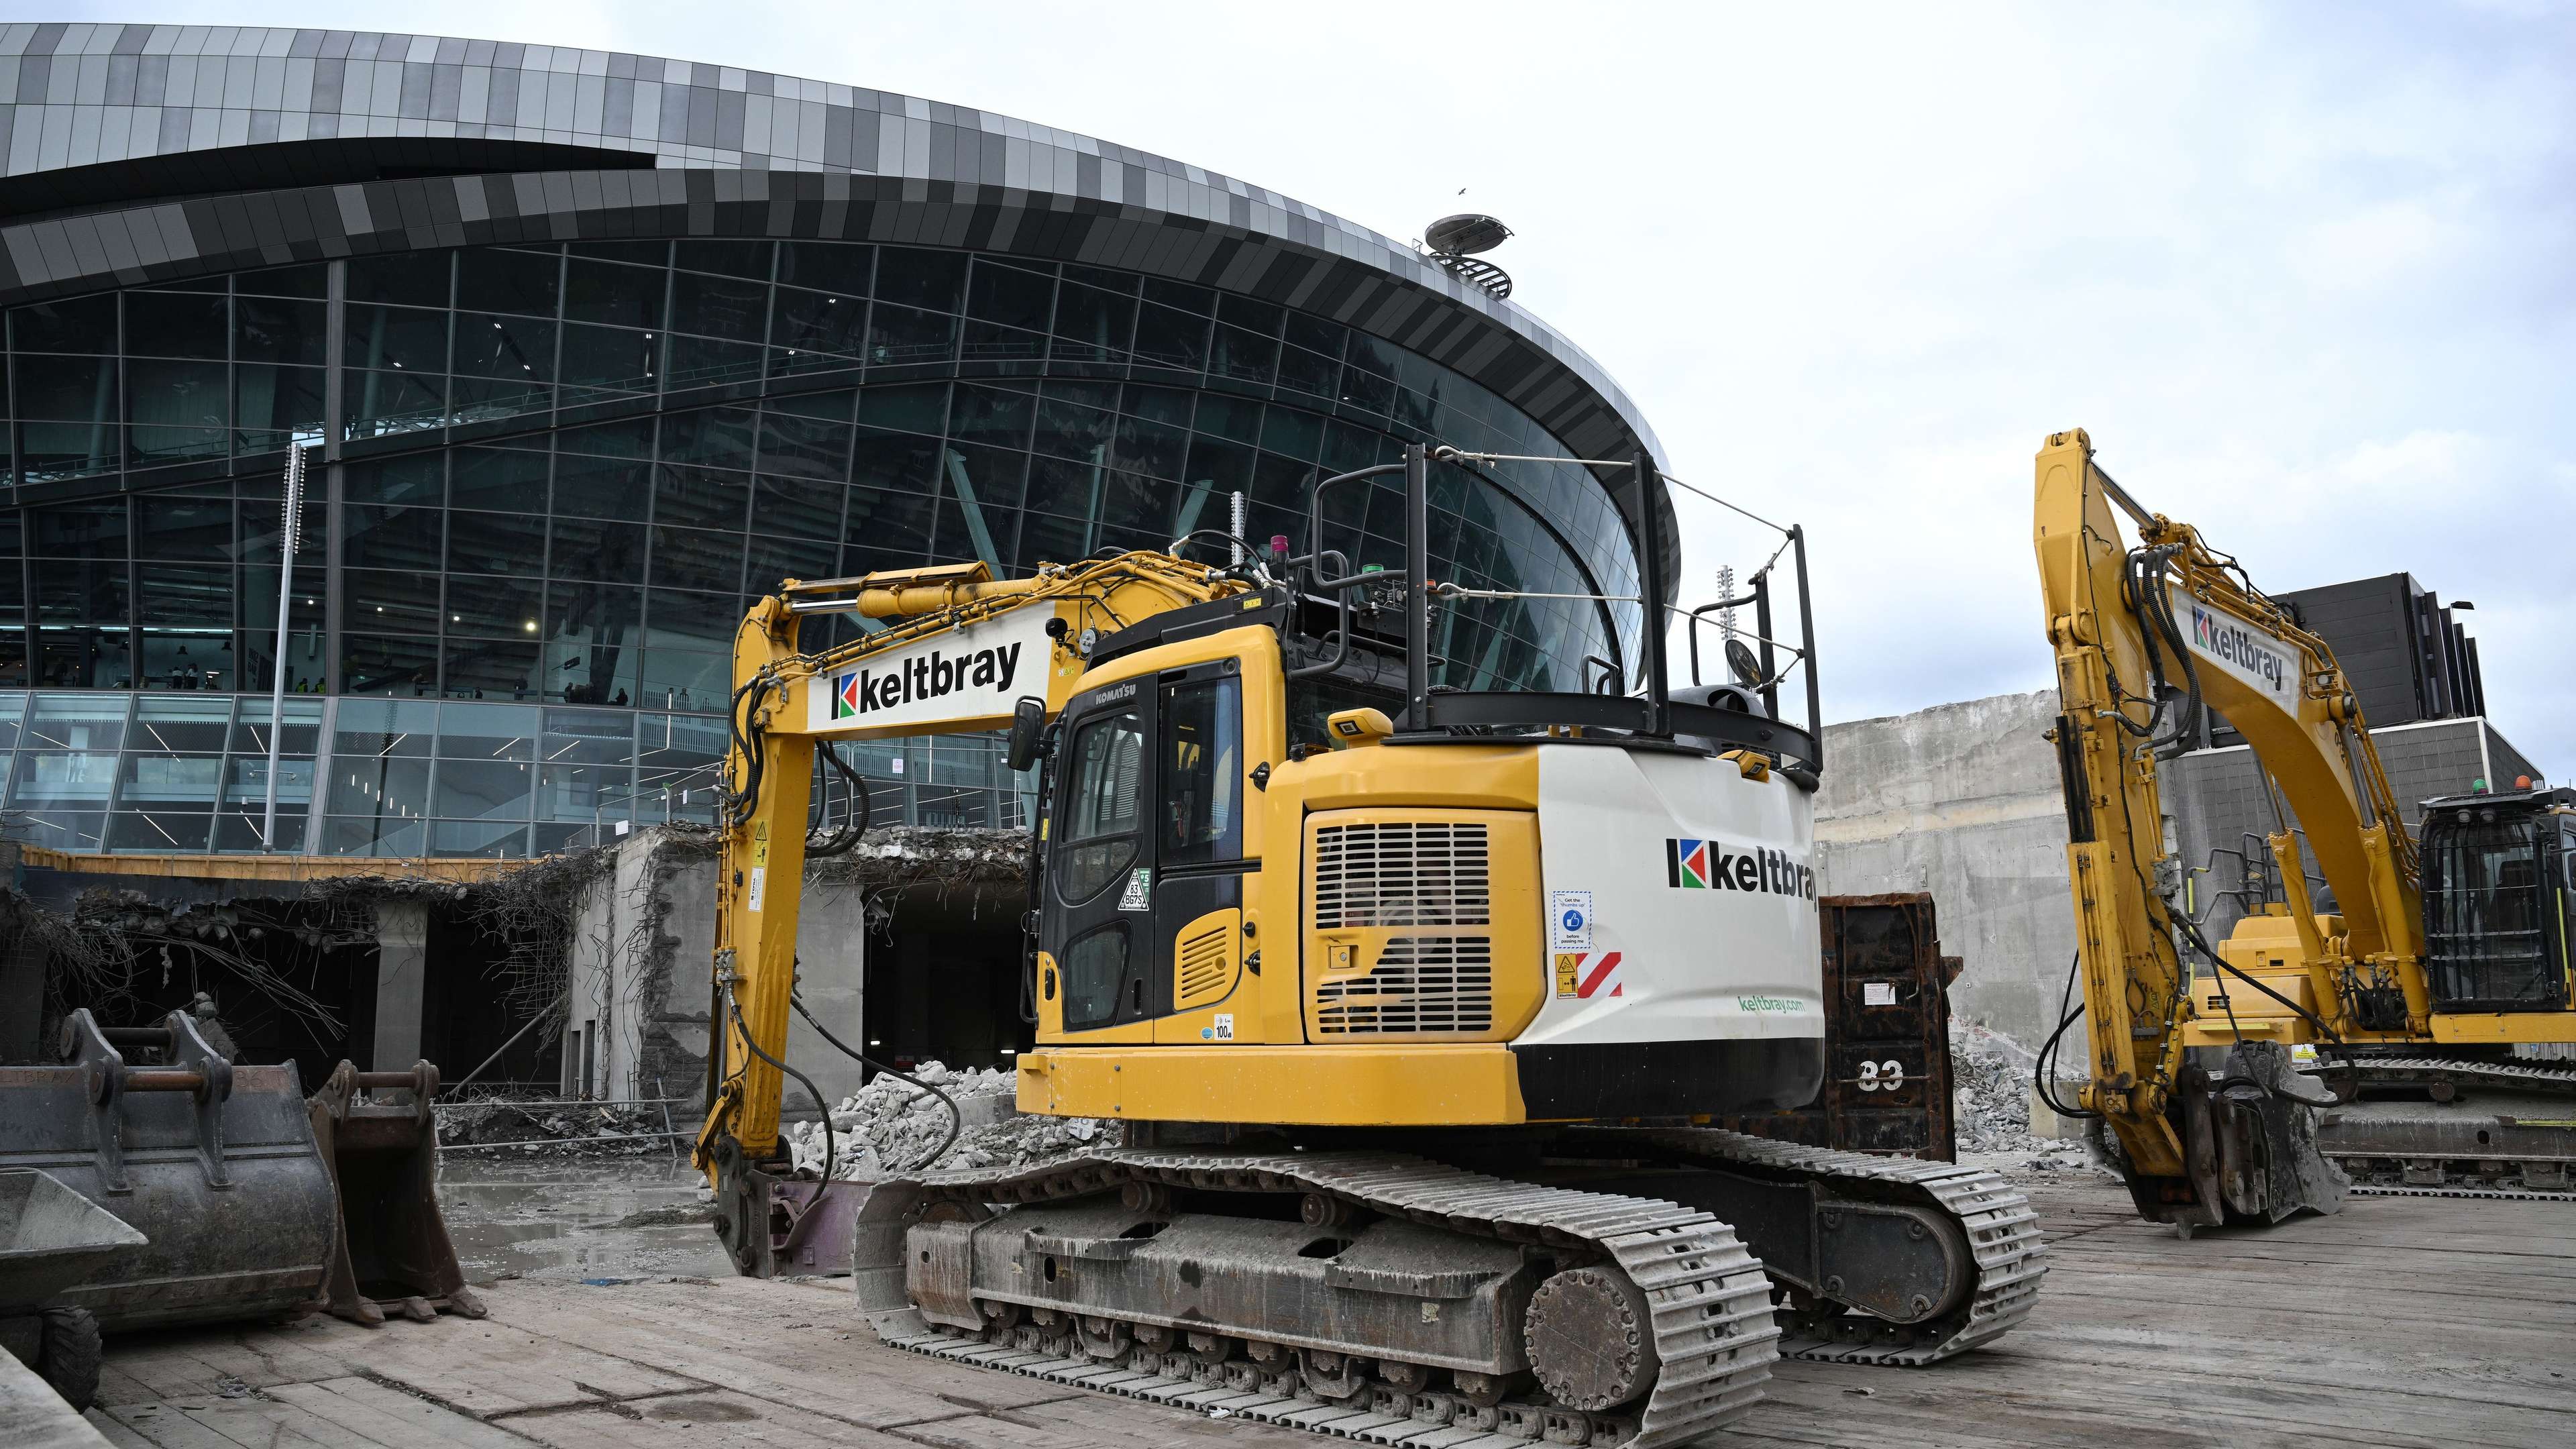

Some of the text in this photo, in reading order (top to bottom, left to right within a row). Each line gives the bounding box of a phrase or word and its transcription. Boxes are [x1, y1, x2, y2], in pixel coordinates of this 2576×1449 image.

[2208, 613, 2282, 691] keltbray
[859, 642, 1022, 714] keltbray
[1095, 684, 1136, 705] KOMATSU
[1130, 884, 1138, 894] 83
[1737, 996, 1805, 1014] keltbray.com
[1216, 1025, 1228, 1038] 100
[1858, 1060, 1904, 1091] 83
